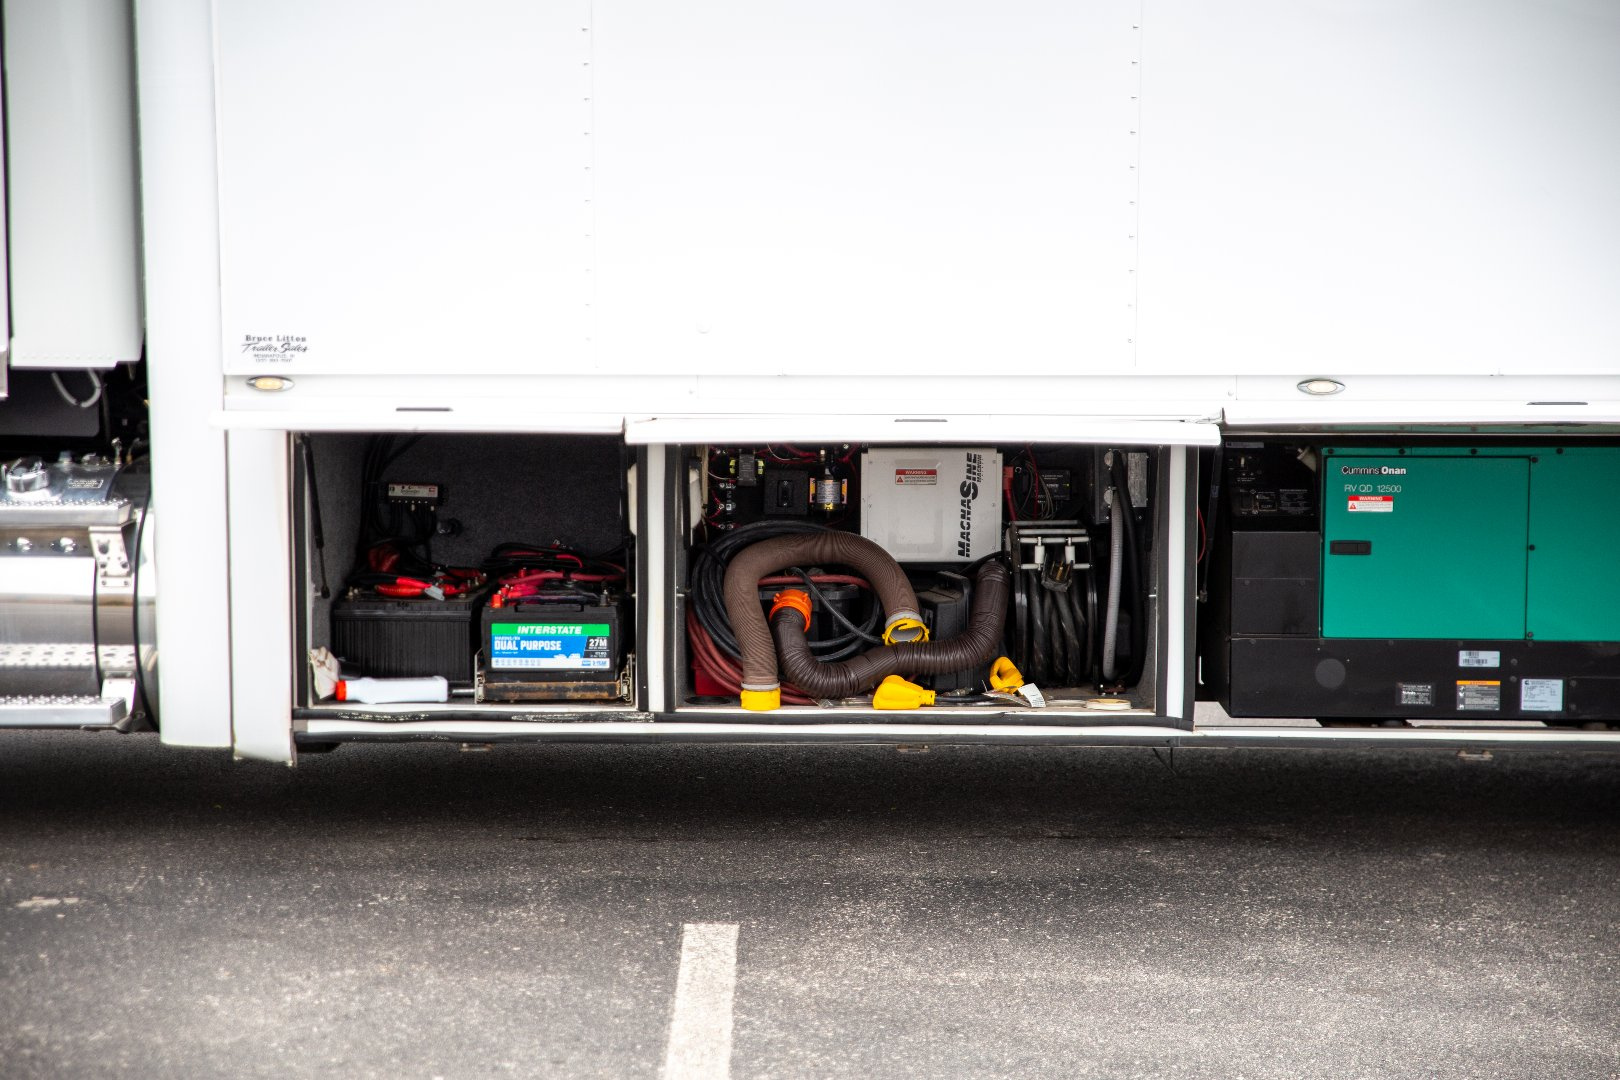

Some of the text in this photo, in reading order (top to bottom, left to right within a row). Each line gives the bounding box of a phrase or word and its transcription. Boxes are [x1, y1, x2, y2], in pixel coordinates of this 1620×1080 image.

[1342, 465, 1407, 475] Cummins Onan
[1344, 484, 1357, 493] RV
[1377, 484, 1402, 493] 12500
[517, 625, 582, 634] INTERSTATE
[494, 640, 562, 651] DUAL PURPOSE
[589, 638, 608, 647] 27M
